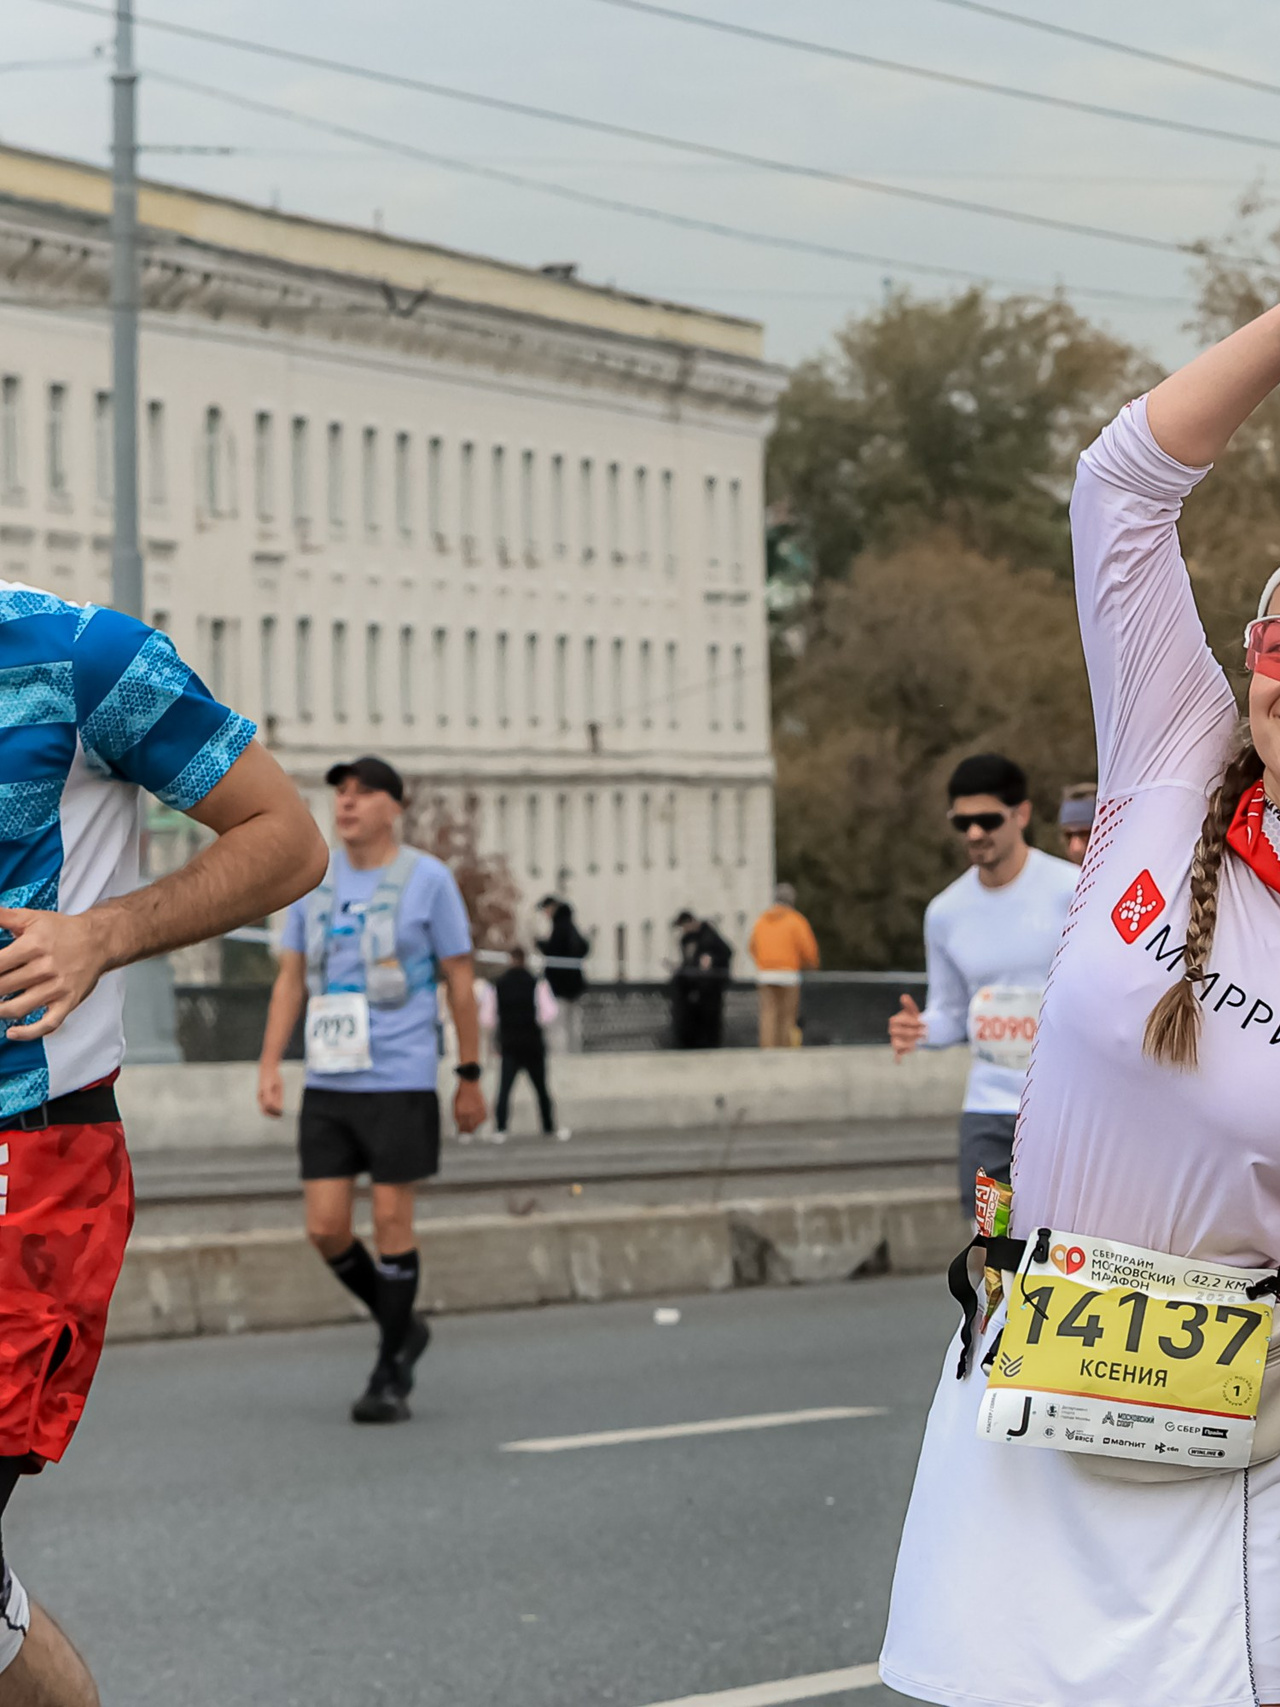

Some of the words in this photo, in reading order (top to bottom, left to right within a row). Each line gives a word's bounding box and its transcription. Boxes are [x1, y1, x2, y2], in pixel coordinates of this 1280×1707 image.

[975, 1015, 1037, 1041] 2090
[1091, 1259, 1176, 1287] МОСКОВСКИЙ
[1191, 1273, 1221, 1289] 42,2
[1022, 1286, 1262, 1367] 14137
[1080, 1358, 1168, 1388] КСЕНИЯ
[1232, 1385, 1241, 1397] 1
[1006, 1396, 1032, 1437] J
[1177, 1424, 1201, 1434] СБЕР
